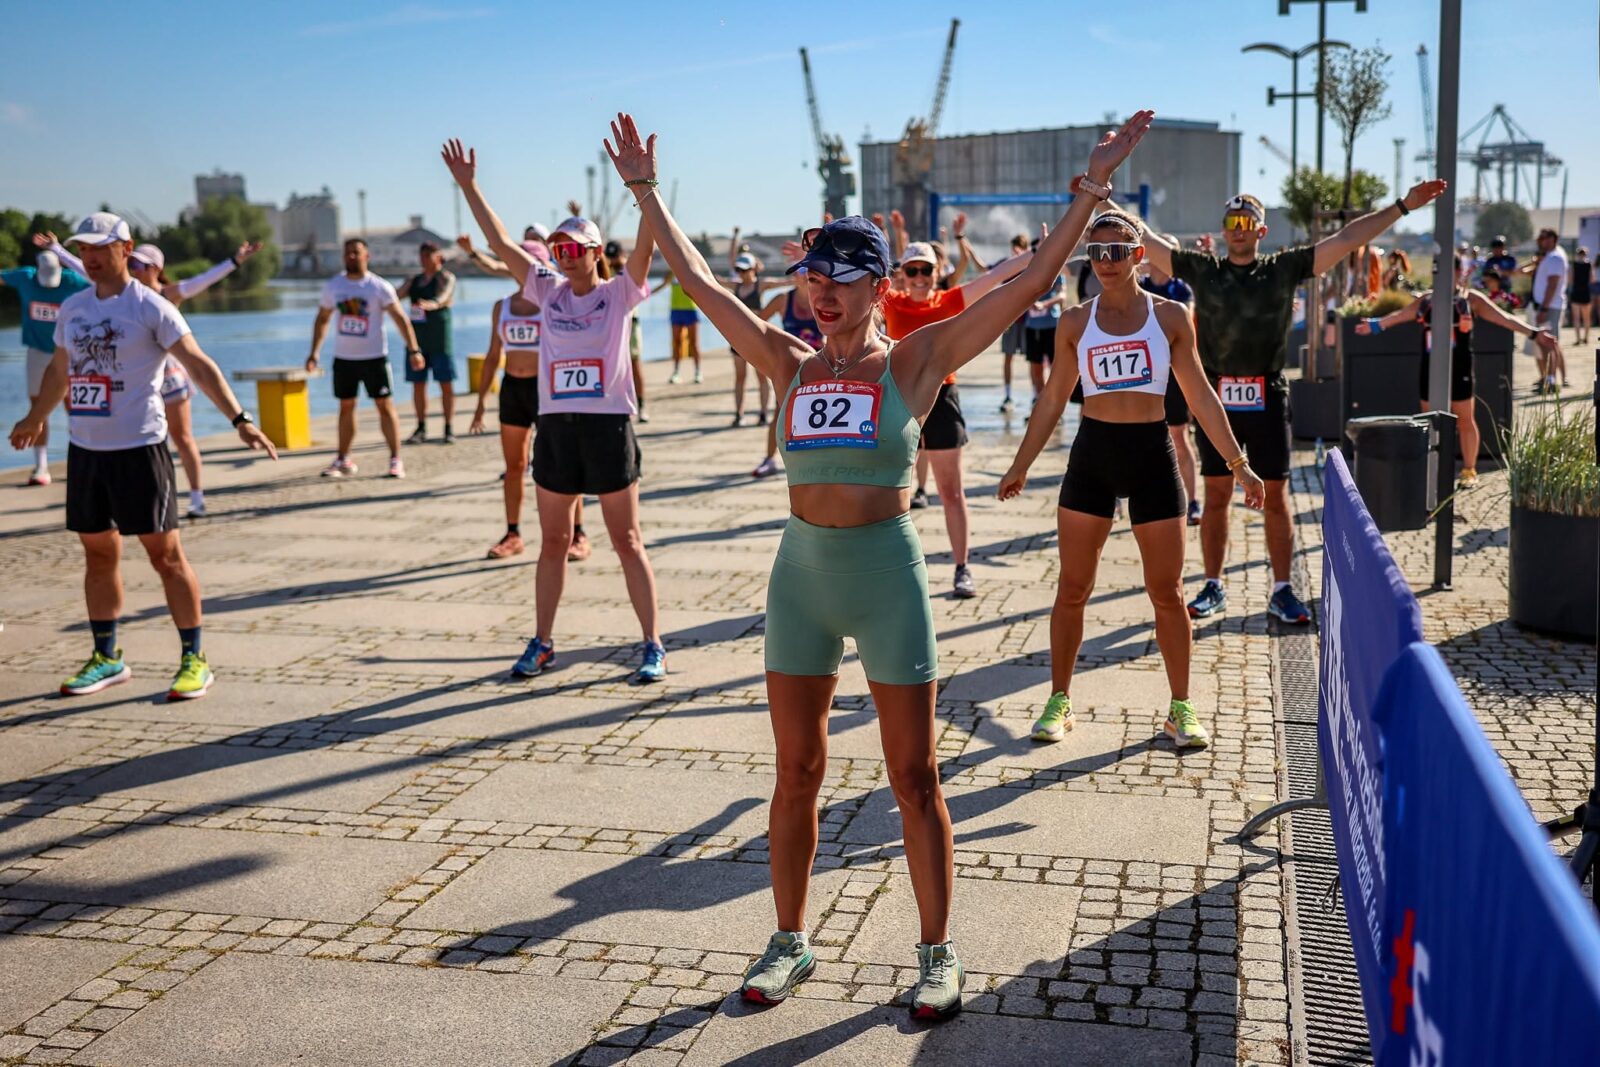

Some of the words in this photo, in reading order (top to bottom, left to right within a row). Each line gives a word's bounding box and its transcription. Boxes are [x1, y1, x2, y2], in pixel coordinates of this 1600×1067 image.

[509, 327, 533, 340] 187
[1099, 353, 1139, 377] 117
[563, 369, 588, 388] 70
[72, 385, 101, 405] 327
[796, 384, 845, 395] BIEGOWE
[1225, 385, 1256, 402] 110
[808, 397, 851, 429] 82
[861, 424, 873, 432] 1/4
